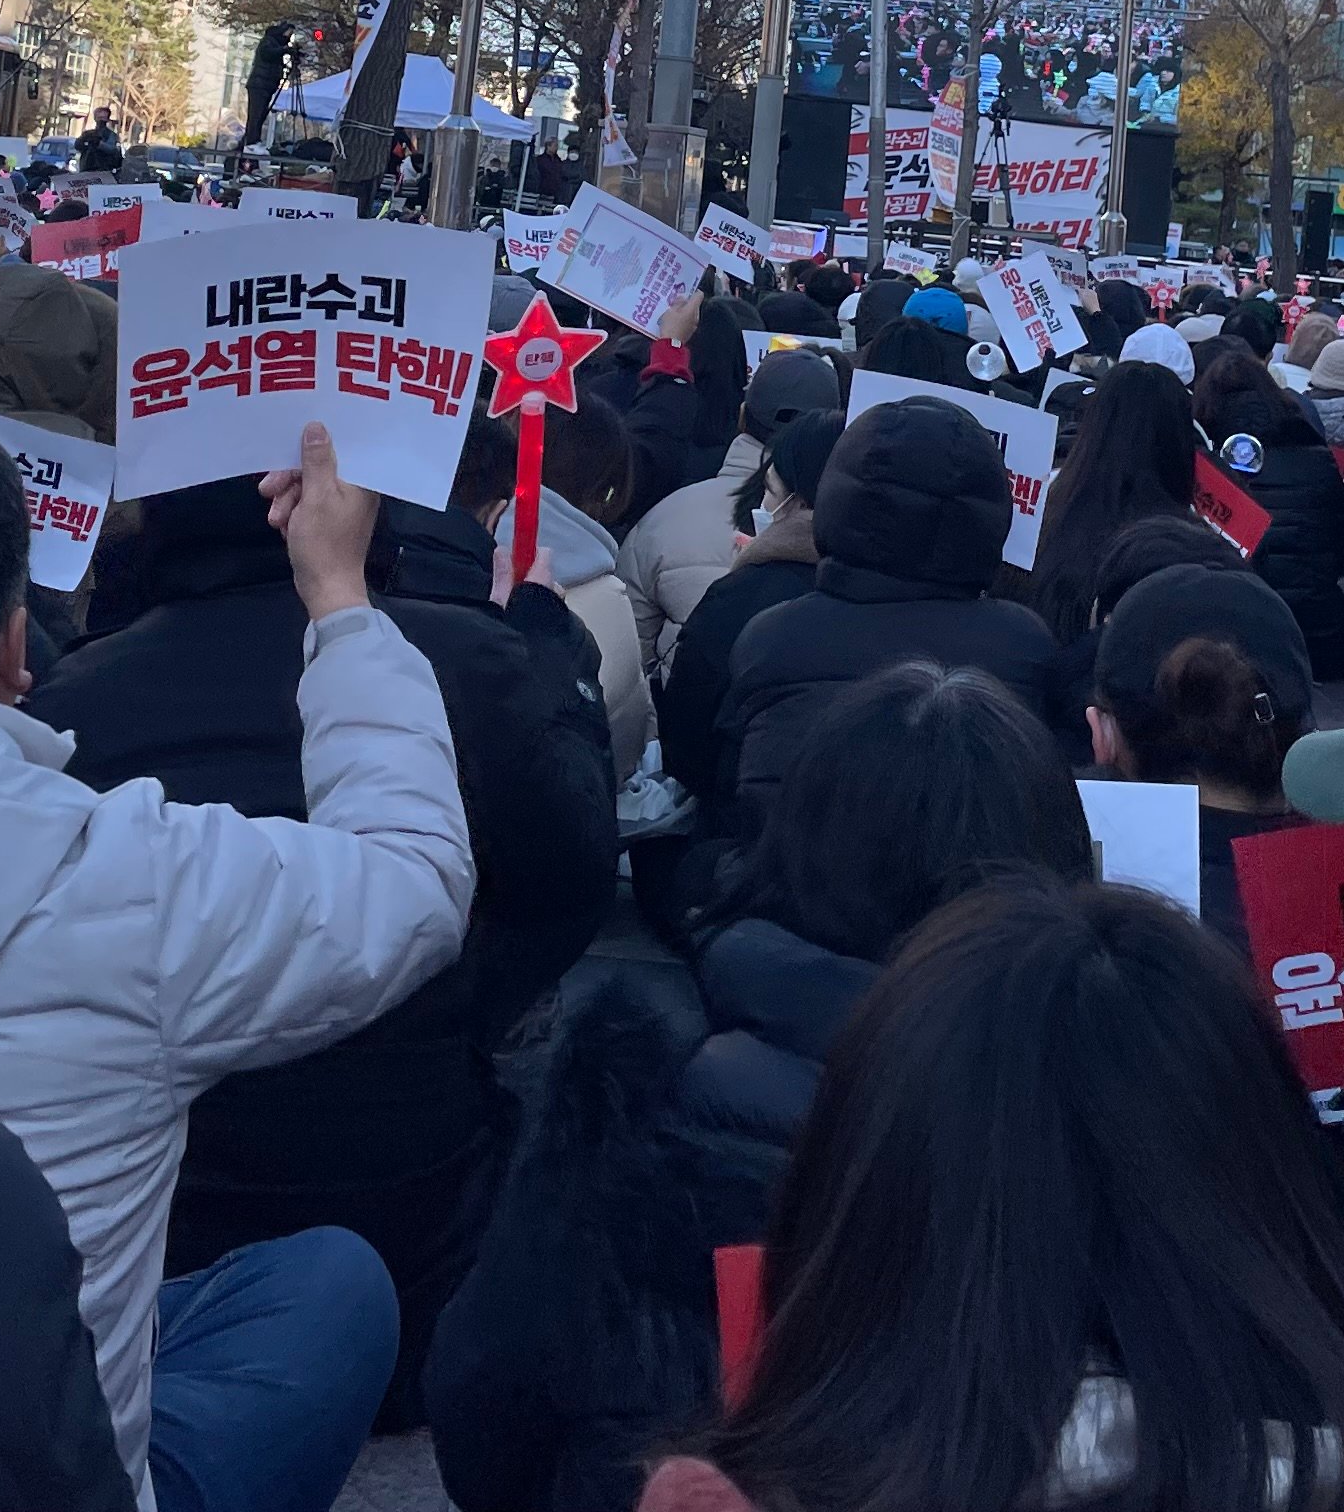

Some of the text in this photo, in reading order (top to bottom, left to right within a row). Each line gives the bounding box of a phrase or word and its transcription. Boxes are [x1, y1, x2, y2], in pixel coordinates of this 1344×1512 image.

[698, 225, 735, 254] 윤석열
[718, 219, 757, 248] 내란수괴
[205, 270, 408, 330] 내란수괴
[999, 266, 1039, 323] 윤석열
[1027, 277, 1064, 336] 내란수괴
[129, 329, 474, 420] 윤석열 탄핵!
[524, 350, 556, 369] 탄핵
